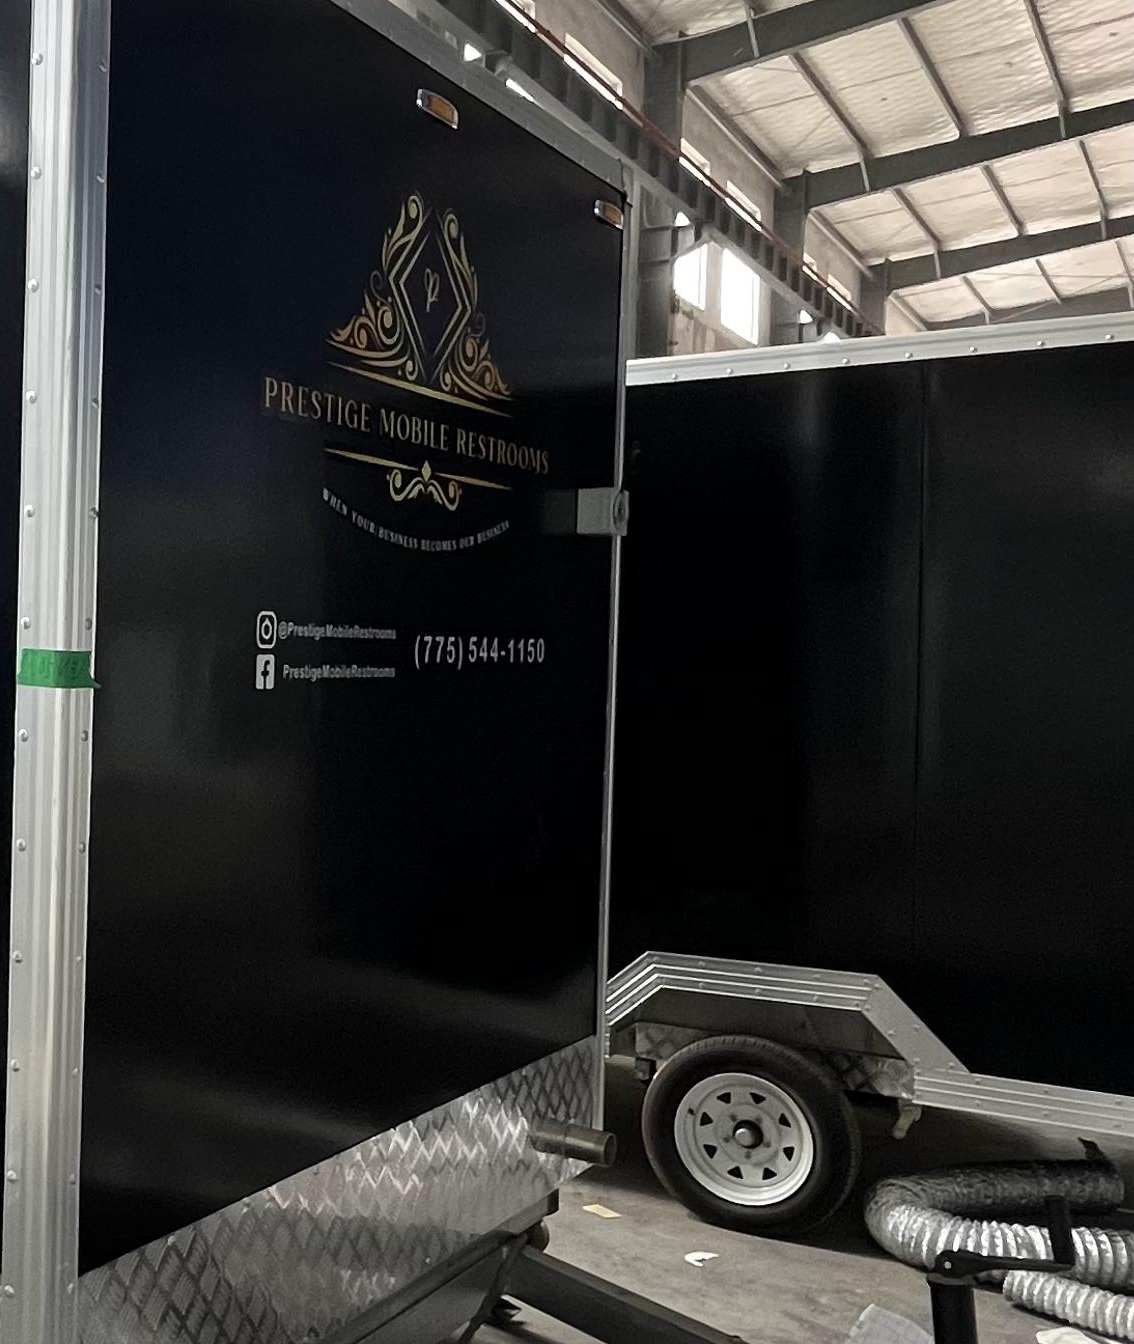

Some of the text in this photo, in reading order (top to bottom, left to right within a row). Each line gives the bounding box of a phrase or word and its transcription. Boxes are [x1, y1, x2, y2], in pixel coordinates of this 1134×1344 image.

[263, 375, 550, 475] PRESTIGE MOBILE RESTROOMS
[322, 487, 347, 517] WHEN
[351, 509, 376, 534] YOUR
[377, 526, 418, 549] BUSINESS
[420, 538, 457, 552] BECOMES
[459, 535, 475, 549] OUR
